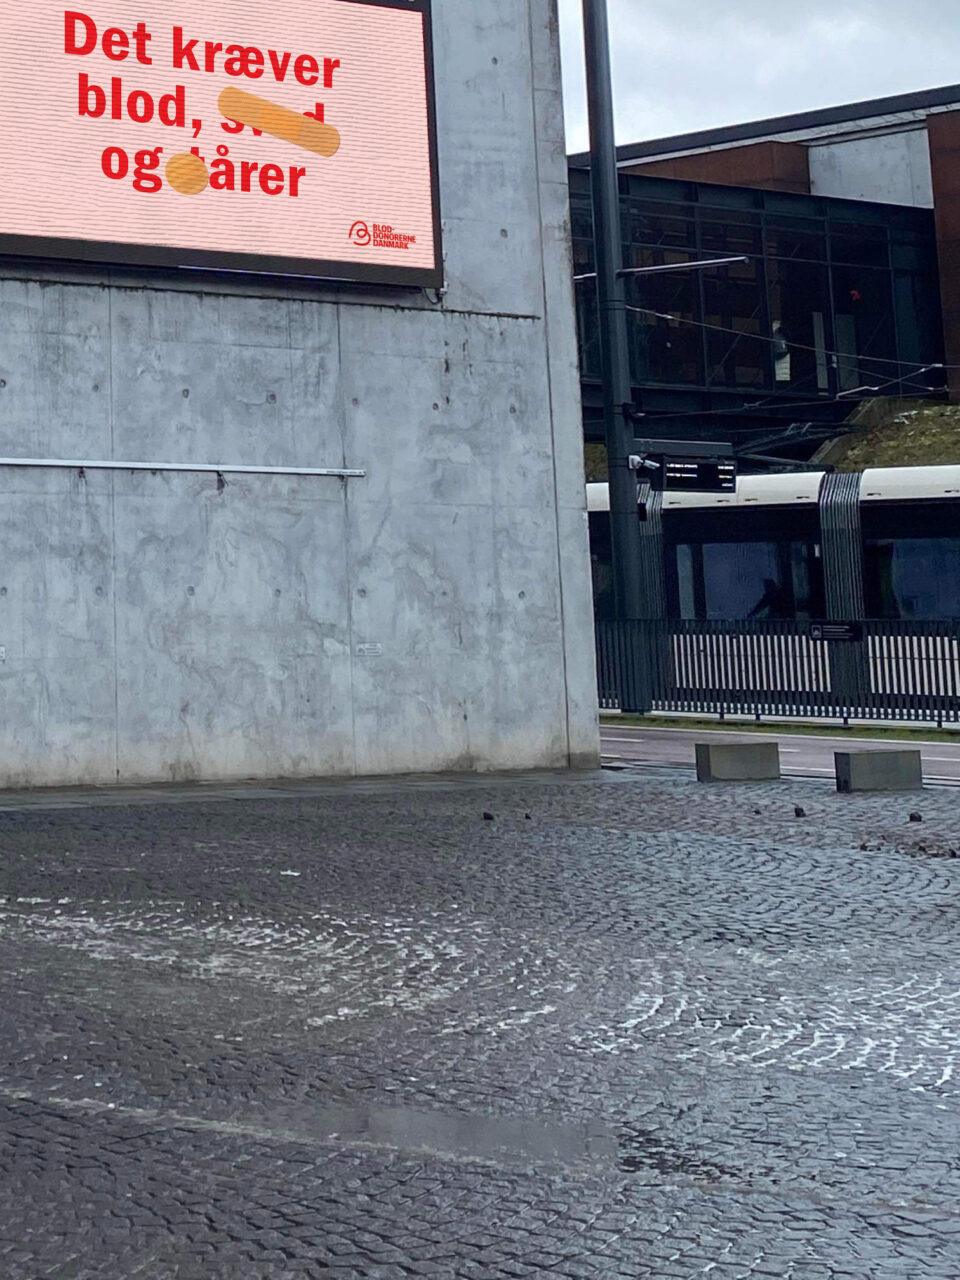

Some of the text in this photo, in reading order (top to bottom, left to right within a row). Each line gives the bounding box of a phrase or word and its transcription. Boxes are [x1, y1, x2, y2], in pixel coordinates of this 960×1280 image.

[64, 10, 341, 89] Det kræver
[78, 72, 202, 139] blod,
[101, 146, 164, 193] og
[373, 239, 409, 249] DANMARK
